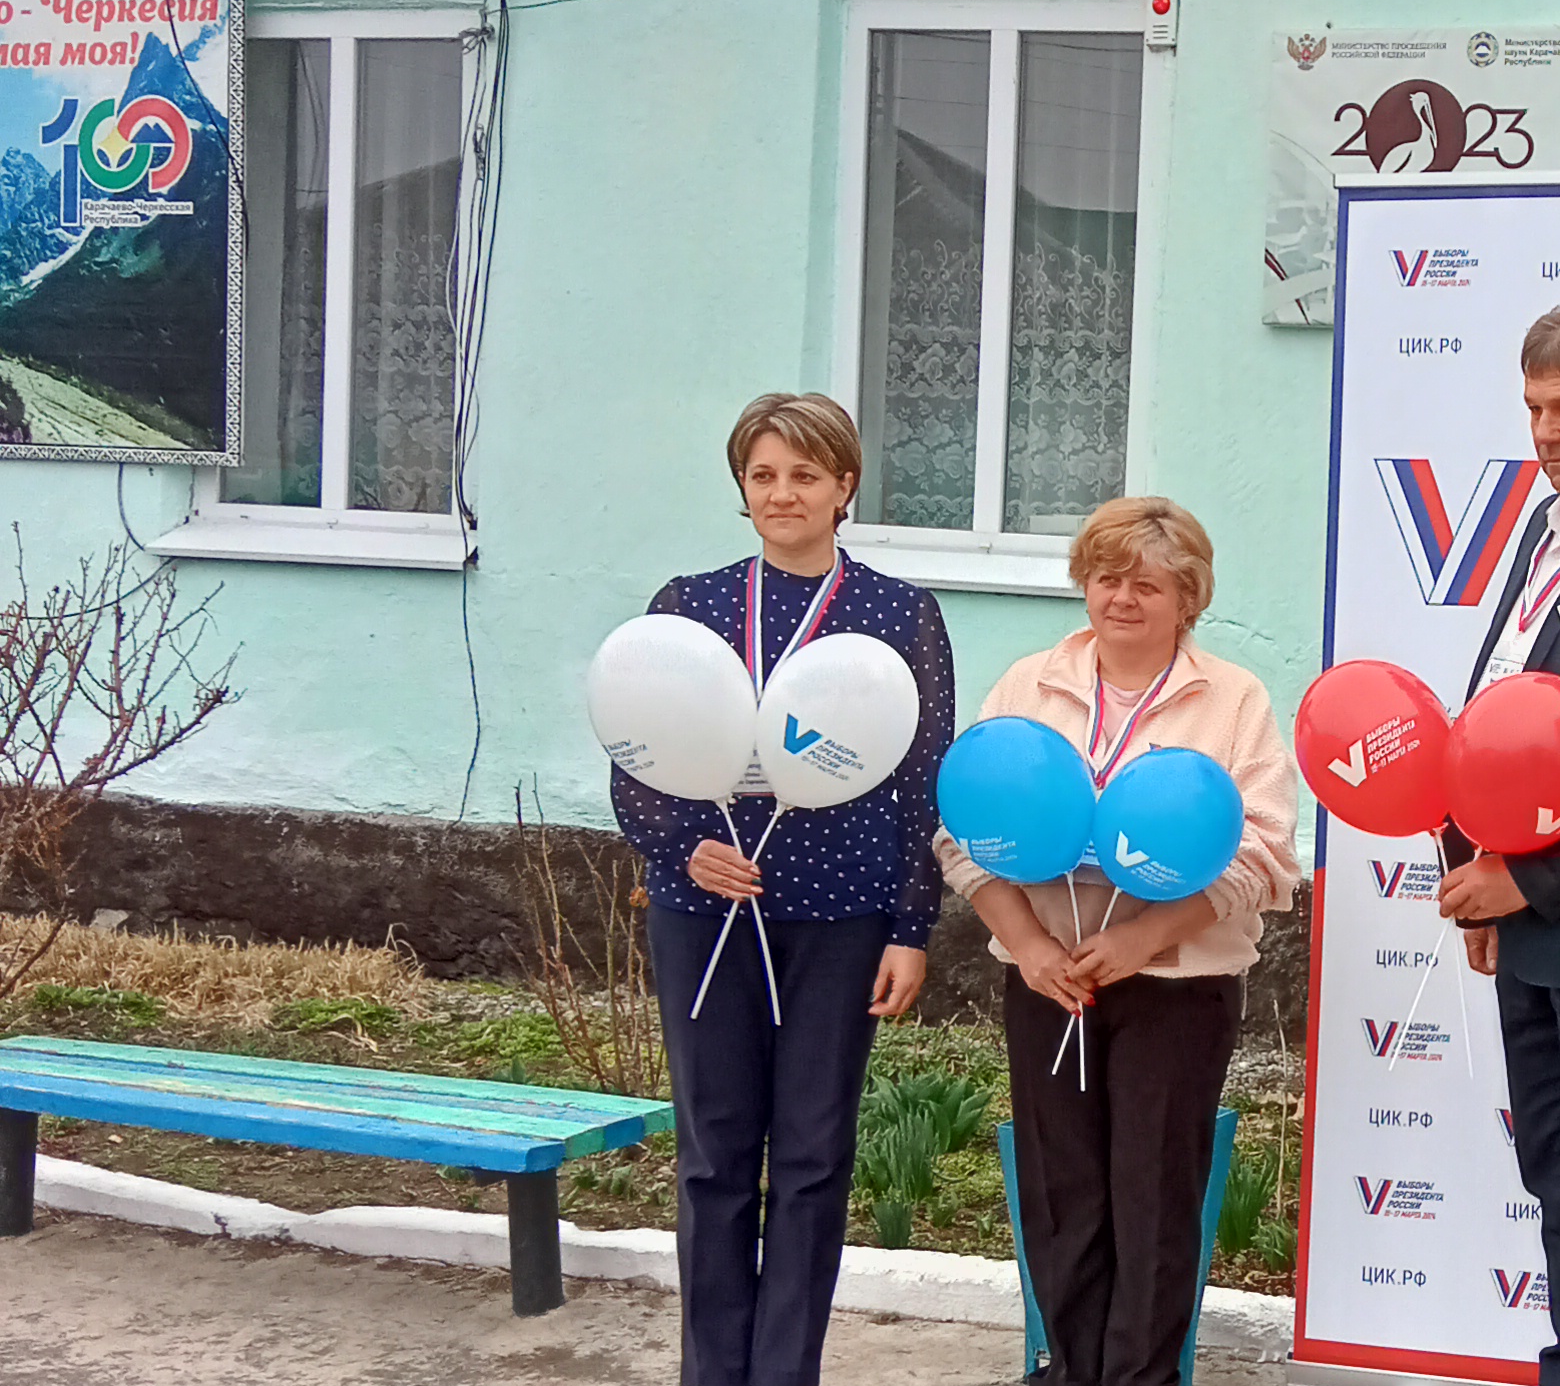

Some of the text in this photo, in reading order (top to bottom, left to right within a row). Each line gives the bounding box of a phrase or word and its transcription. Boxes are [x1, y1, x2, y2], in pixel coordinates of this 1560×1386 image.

[59, 31, 139, 66] моя!
[84, 202, 190, 212] Карачаево-Черкесская
[84, 215, 138, 225] Республика
[1433, 249, 1469, 257] ВЫБОРЫ
[1428, 259, 1479, 268] ПРЕЗИДЕНТА
[1399, 337, 1463, 355] ЦИК.РФ
[1366, 716, 1400, 743] ВЫБОРЫ
[1369, 738, 1400, 765] РОССИИ
[1409, 863, 1440, 872] ВЫБОР
[1401, 883, 1433, 891] РОССИИ
[1376, 949, 1440, 971] ЦИК.РФ
[1368, 1108, 1433, 1129] ЦИК.РФ
[1396, 1180, 1434, 1190] ВЫБОРЫ
[1391, 1191, 1444, 1201] ПРЕЗИДЕНТА
[1387, 1200, 1422, 1209] РОССИИ
[1506, 1202, 1541, 1222] ЦИК
[1361, 1265, 1427, 1288] ЦИК.РФ
